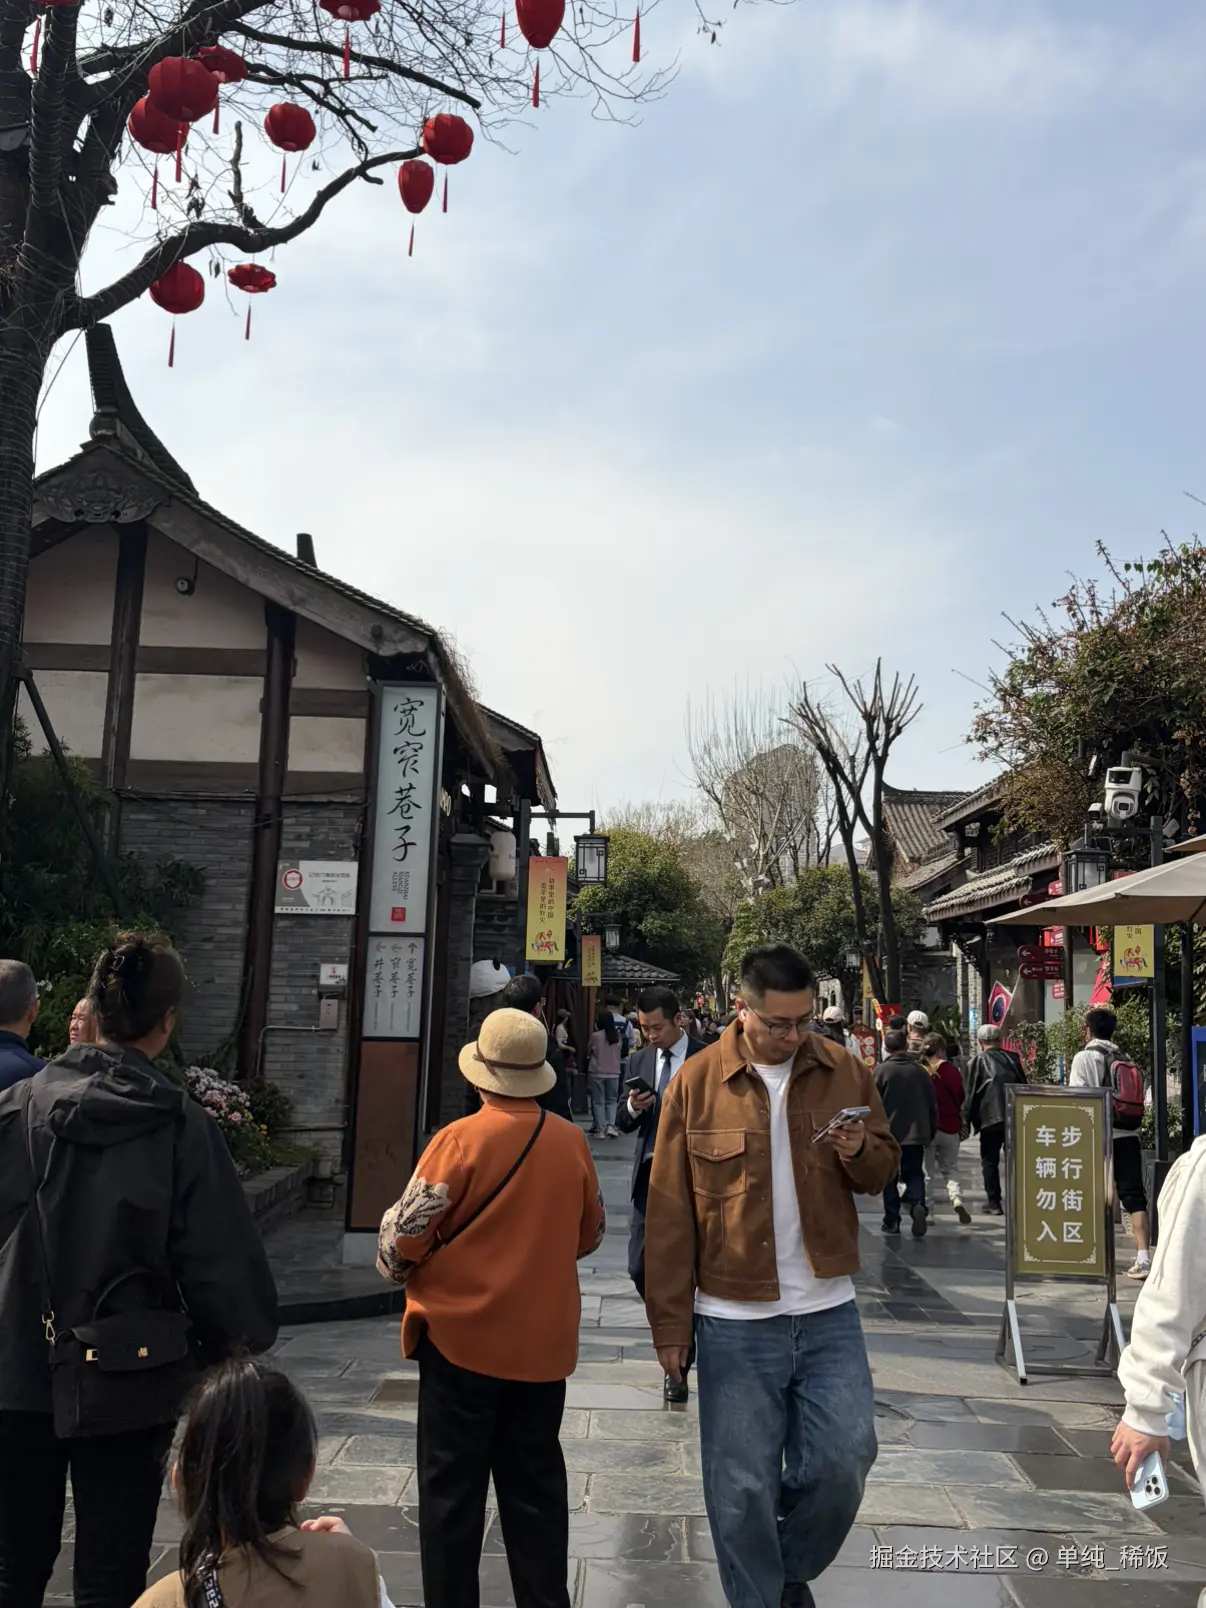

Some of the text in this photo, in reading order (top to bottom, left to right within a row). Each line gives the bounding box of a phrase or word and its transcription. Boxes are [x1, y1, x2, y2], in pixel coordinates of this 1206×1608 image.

[387, 698, 426, 861] 宽窄巷子
[547, 877, 555, 919] 故事里的中国
[373, 957, 384, 998] 井巷子
[389, 957, 401, 998] 窄巷子
[405, 958, 418, 998] 宽巷子
[1036, 1125, 1057, 1242] 车辆勿入
[1061, 1126, 1083, 1243] 步行街区
